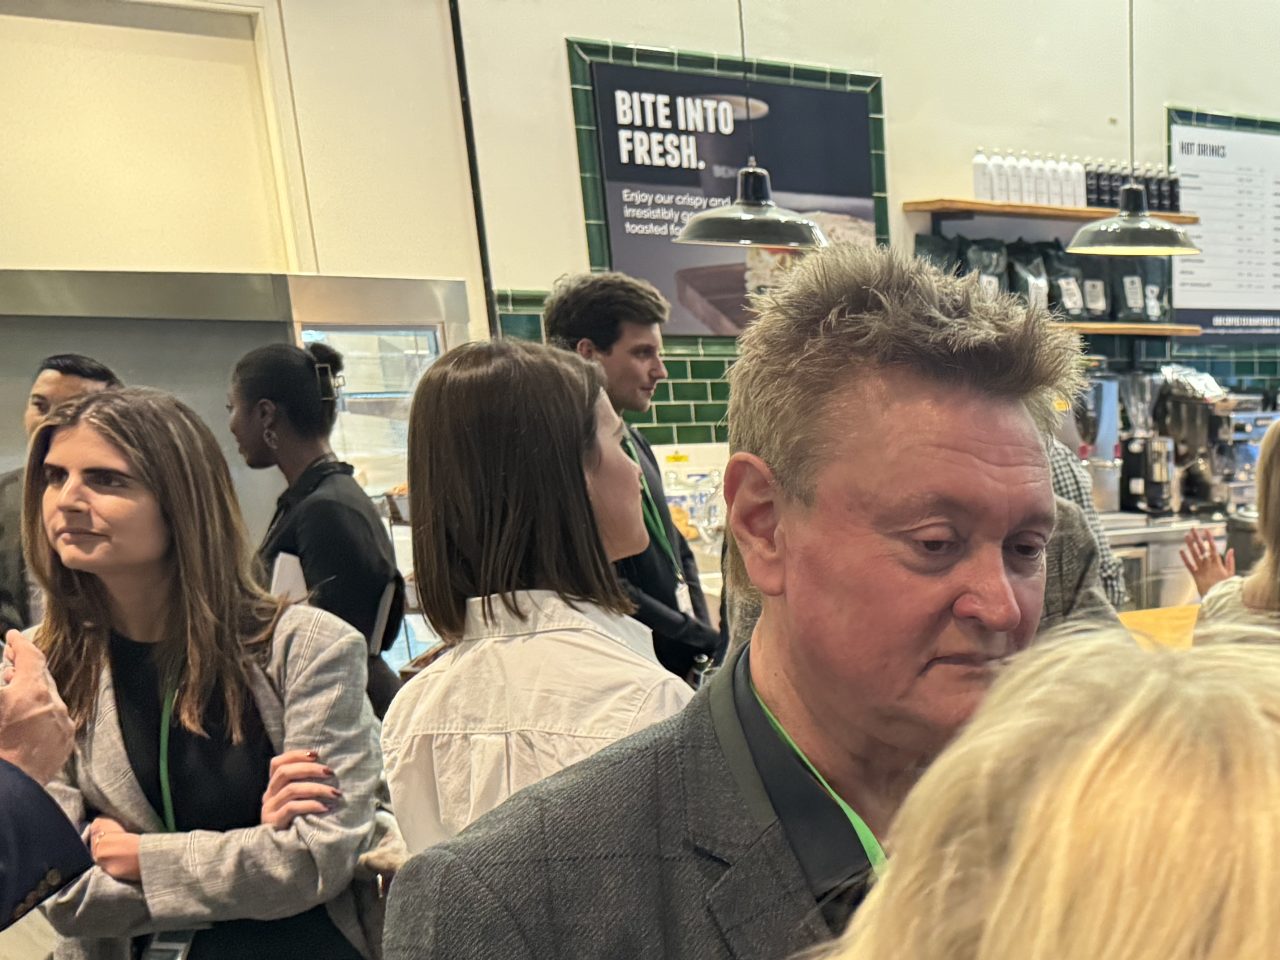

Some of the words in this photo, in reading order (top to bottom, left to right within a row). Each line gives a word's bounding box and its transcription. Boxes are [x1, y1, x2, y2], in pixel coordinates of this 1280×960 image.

[615, 89, 672, 129] BITE
[676, 96, 735, 135] INTO
[618, 129, 706, 169] FRESH.
[622, 188, 654, 206] Enjoy
[654, 193, 675, 205] our
[674, 192, 709, 210] crispy
[708, 196, 732, 208] and
[623, 204, 681, 224] irresistibly
[624, 221, 669, 236] toasted
